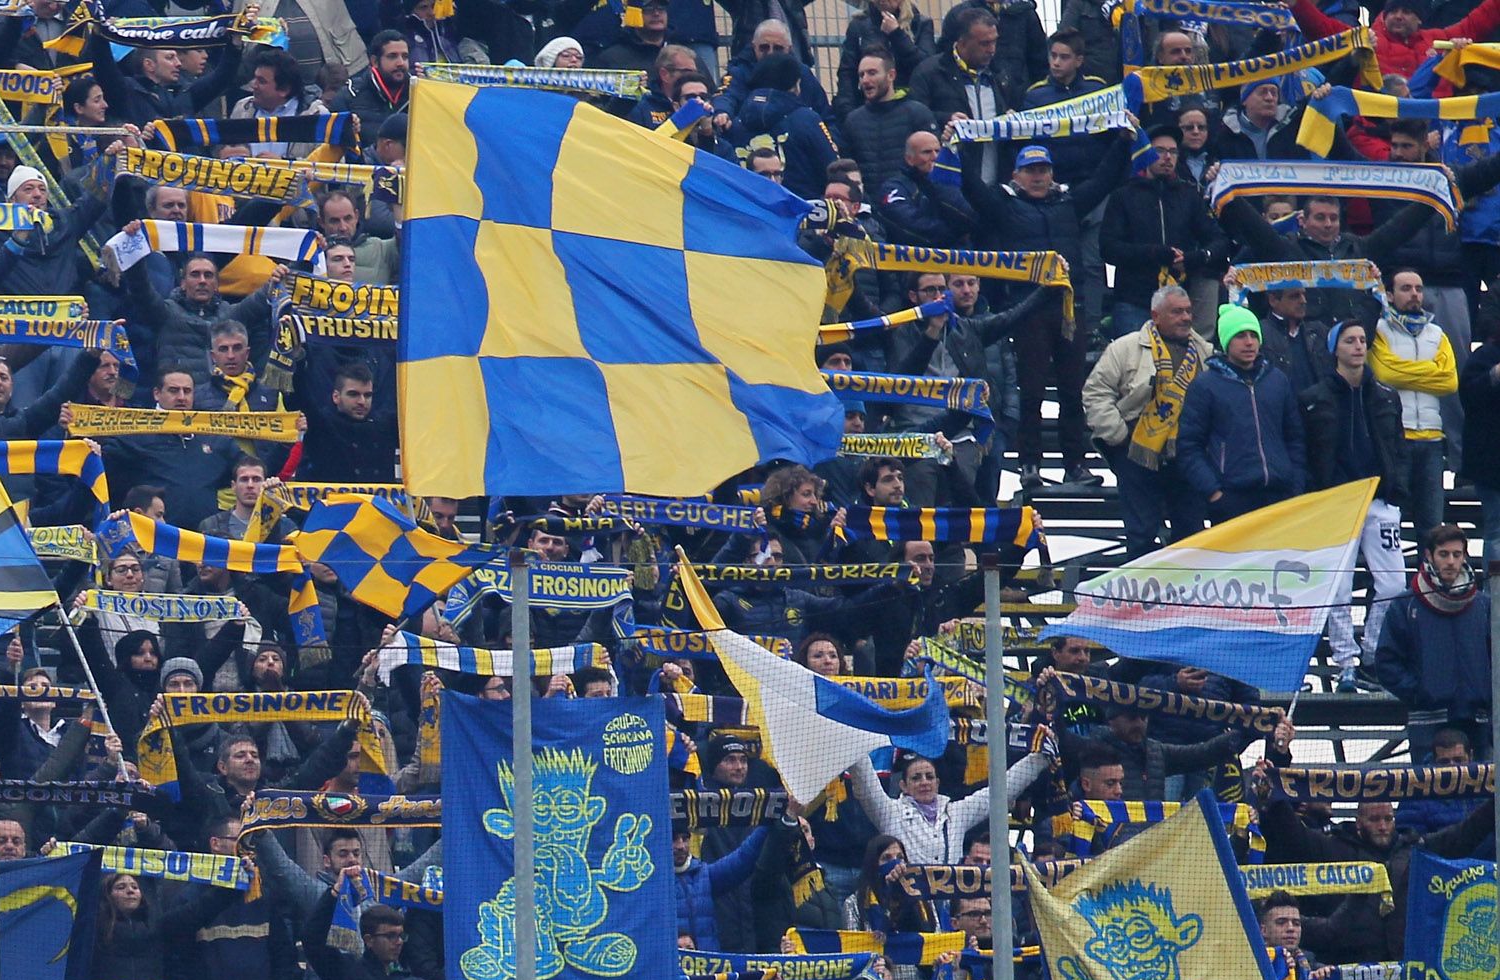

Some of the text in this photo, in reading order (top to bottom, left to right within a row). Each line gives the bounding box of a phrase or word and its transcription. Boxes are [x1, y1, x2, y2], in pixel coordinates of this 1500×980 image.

[1214, 33, 1353, 83] FROSINONE
[126, 148, 298, 198] FROSINONE
[878, 244, 1028, 271] FROSINONE
[292, 276, 399, 316] FROSIN
[25, 318, 86, 339] 100%
[830, 375, 950, 401] OSINONE
[292, 486, 405, 506] FROSINON
[563, 517, 614, 532] MIA
[607, 499, 752, 527] BERT GUCHE
[468, 565, 515, 592] FORZ
[173, 691, 345, 717] FROSINONE
[604, 713, 647, 733] GRUPPO
[603, 743, 653, 776] FROSINONE
[669, 788, 786, 819] EROE
[1316, 861, 1374, 887] CALCIO
